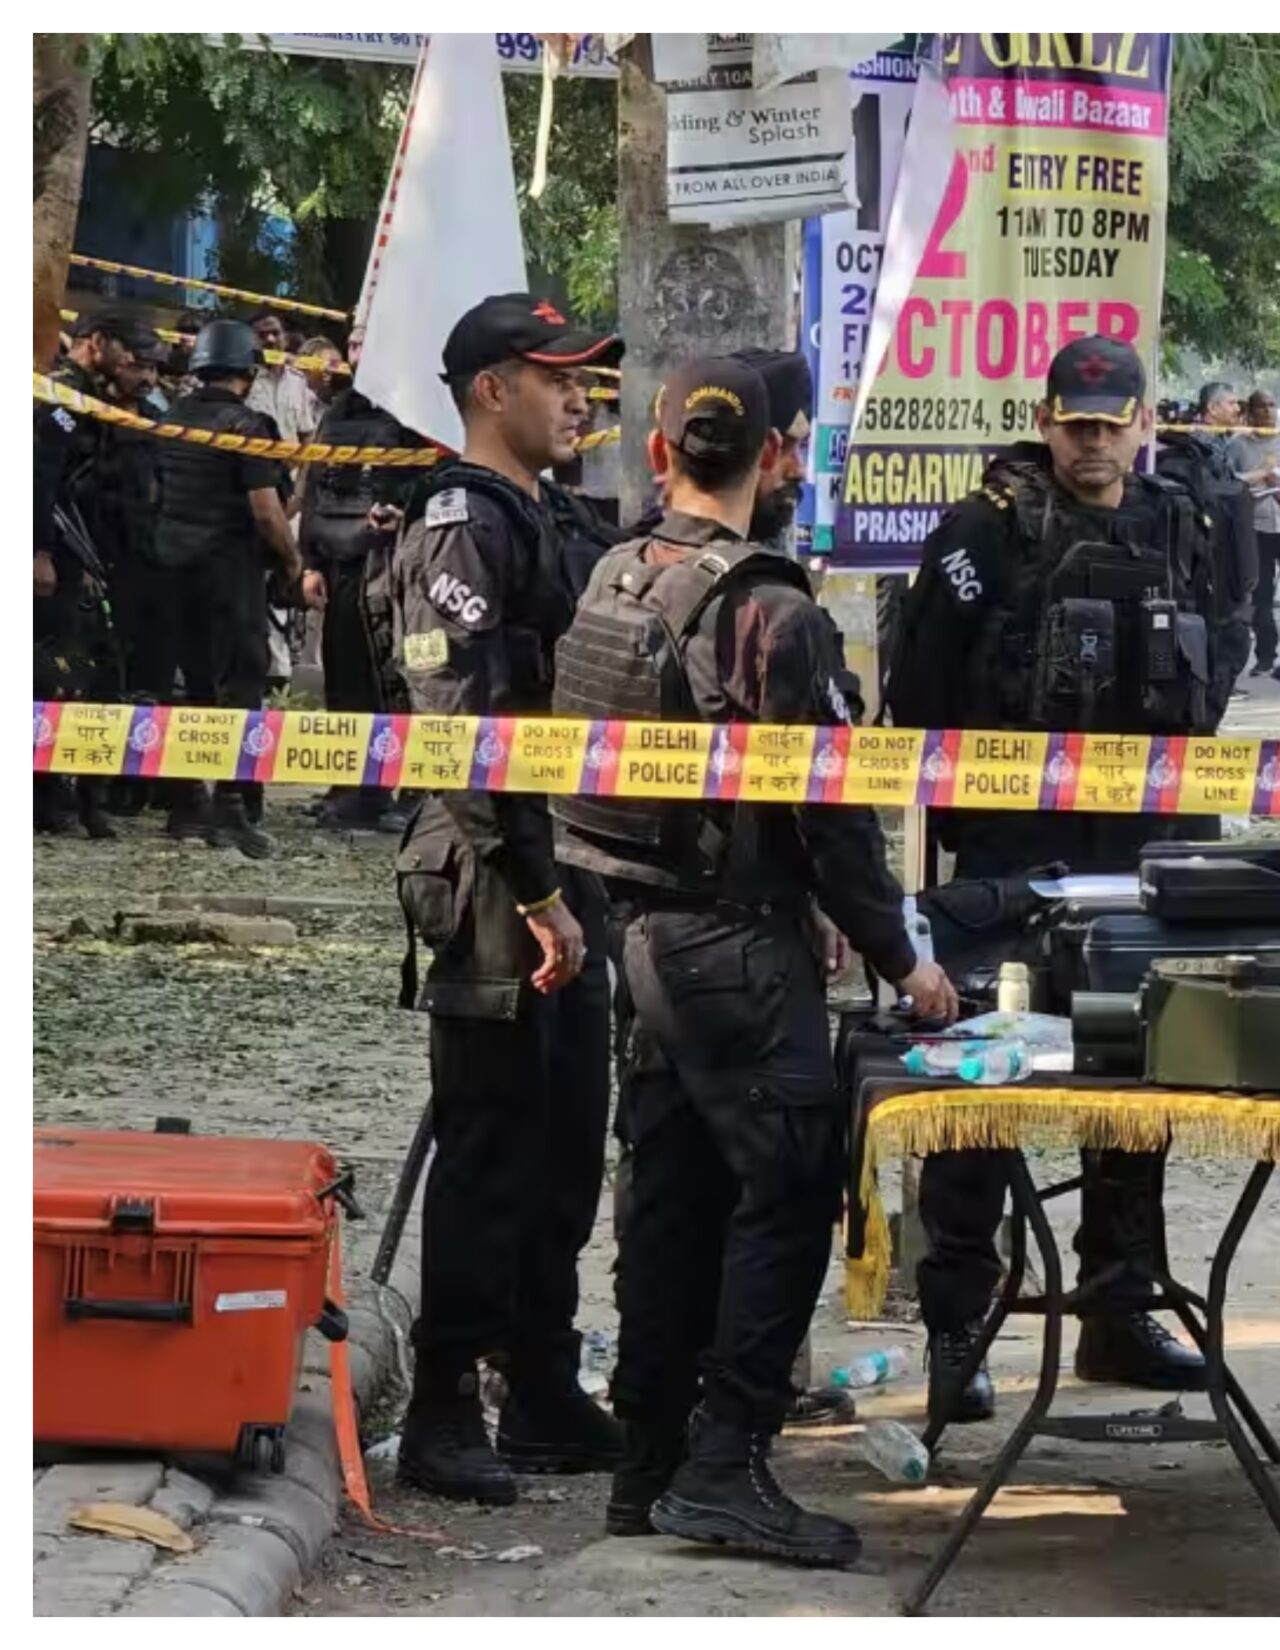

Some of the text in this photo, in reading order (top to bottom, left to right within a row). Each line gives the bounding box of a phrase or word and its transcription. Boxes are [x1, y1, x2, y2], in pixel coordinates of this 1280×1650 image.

[988, 86, 1005, 119] &
[1072, 90, 1150, 130] Bazaar
[725, 110, 745, 129] &
[751, 107, 821, 126] Winter
[748, 122, 819, 146] Splash
[676, 177, 717, 194] FROM
[751, 171, 791, 189] OVER
[796, 166, 838, 184] INDIA
[1076, 156, 1143, 196] FREE
[1055, 207, 1084, 239] TO
[1093, 208, 1150, 243] 8PM
[1023, 246, 1121, 279] TUESDAY
[857, 397, 991, 437] 582828274,
[846, 452, 997, 503] AGGARWA
[854, 509, 946, 543] PRASHA
[942, 548, 983, 601] NSG
[429, 573, 488, 623] NSG
[179, 712, 238, 726] DO NOT
[300, 716, 357, 737] DELHI
[78, 726, 109, 741] पार
[178, 730, 230, 744] CROSS
[524, 725, 581, 740] DO NOT
[640, 728, 698, 750] DELHI
[423, 740, 455, 756] पार
[859, 736, 916, 751] DO NOT
[976, 738, 1033, 761] DELHI
[62, 748, 77, 764] न
[186, 751, 222, 765] LINE
[286, 747, 358, 771] POLICE
[524, 745, 574, 759] CROSS
[1195, 746, 1251, 761] DO NOT
[763, 754, 792, 769] पार
[859, 757, 910, 771] CROSS
[410, 762, 424, 778] न
[531, 764, 565, 779] LINE
[629, 762, 699, 785] POLICE
[1098, 765, 1126, 780] पार
[1195, 766, 1246, 780] CROSS
[749, 779, 765, 791] न
[867, 777, 901, 791] LINE
[965, 772, 1032, 795] POLICE
[1084, 788, 1099, 801] न
[1204, 787, 1239, 801] LINE
